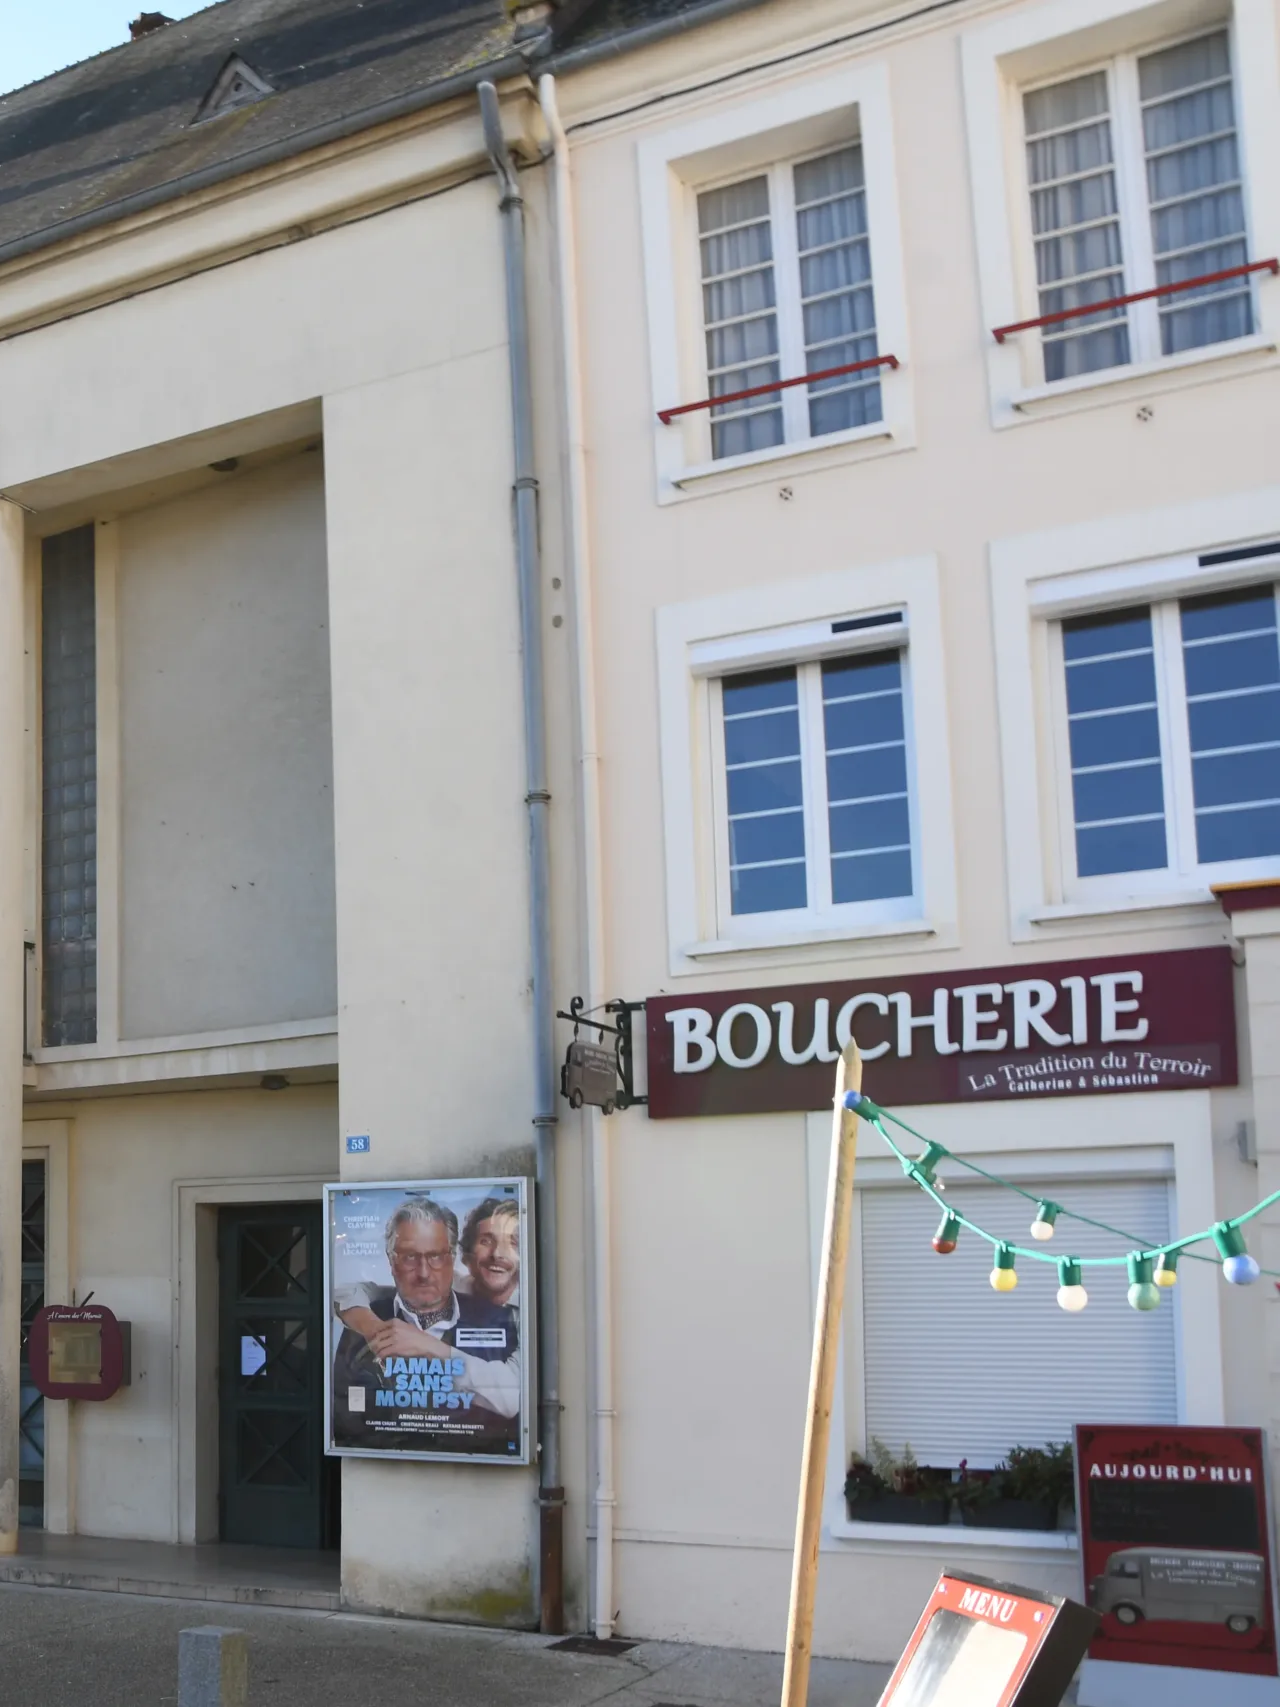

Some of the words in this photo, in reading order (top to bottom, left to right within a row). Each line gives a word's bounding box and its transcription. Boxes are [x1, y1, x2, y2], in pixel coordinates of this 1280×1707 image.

[665, 970, 1149, 1073] BOUCHERIE
[968, 1074, 997, 1092] La
[998, 1054, 1095, 1082] Tradition
[1101, 1051, 1128, 1069] du
[1134, 1051, 1212, 1079] Terroir
[1009, 1079, 1072, 1093] Catherine
[1078, 1075, 1087, 1088] &
[1092, 1072, 1159, 1087] Sébastien
[351, 1138, 365, 1150] 58
[383, 1356, 466, 1377] JAMAIS
[395, 1373, 454, 1392] SANS
[375, 1389, 428, 1408] MON
[432, 1391, 475, 1410] PSY
[398, 1413, 424, 1421] ARNAUD
[1089, 1463, 1254, 1483] AUJOURD'HUI
[958, 1587, 1018, 1623] MENU
